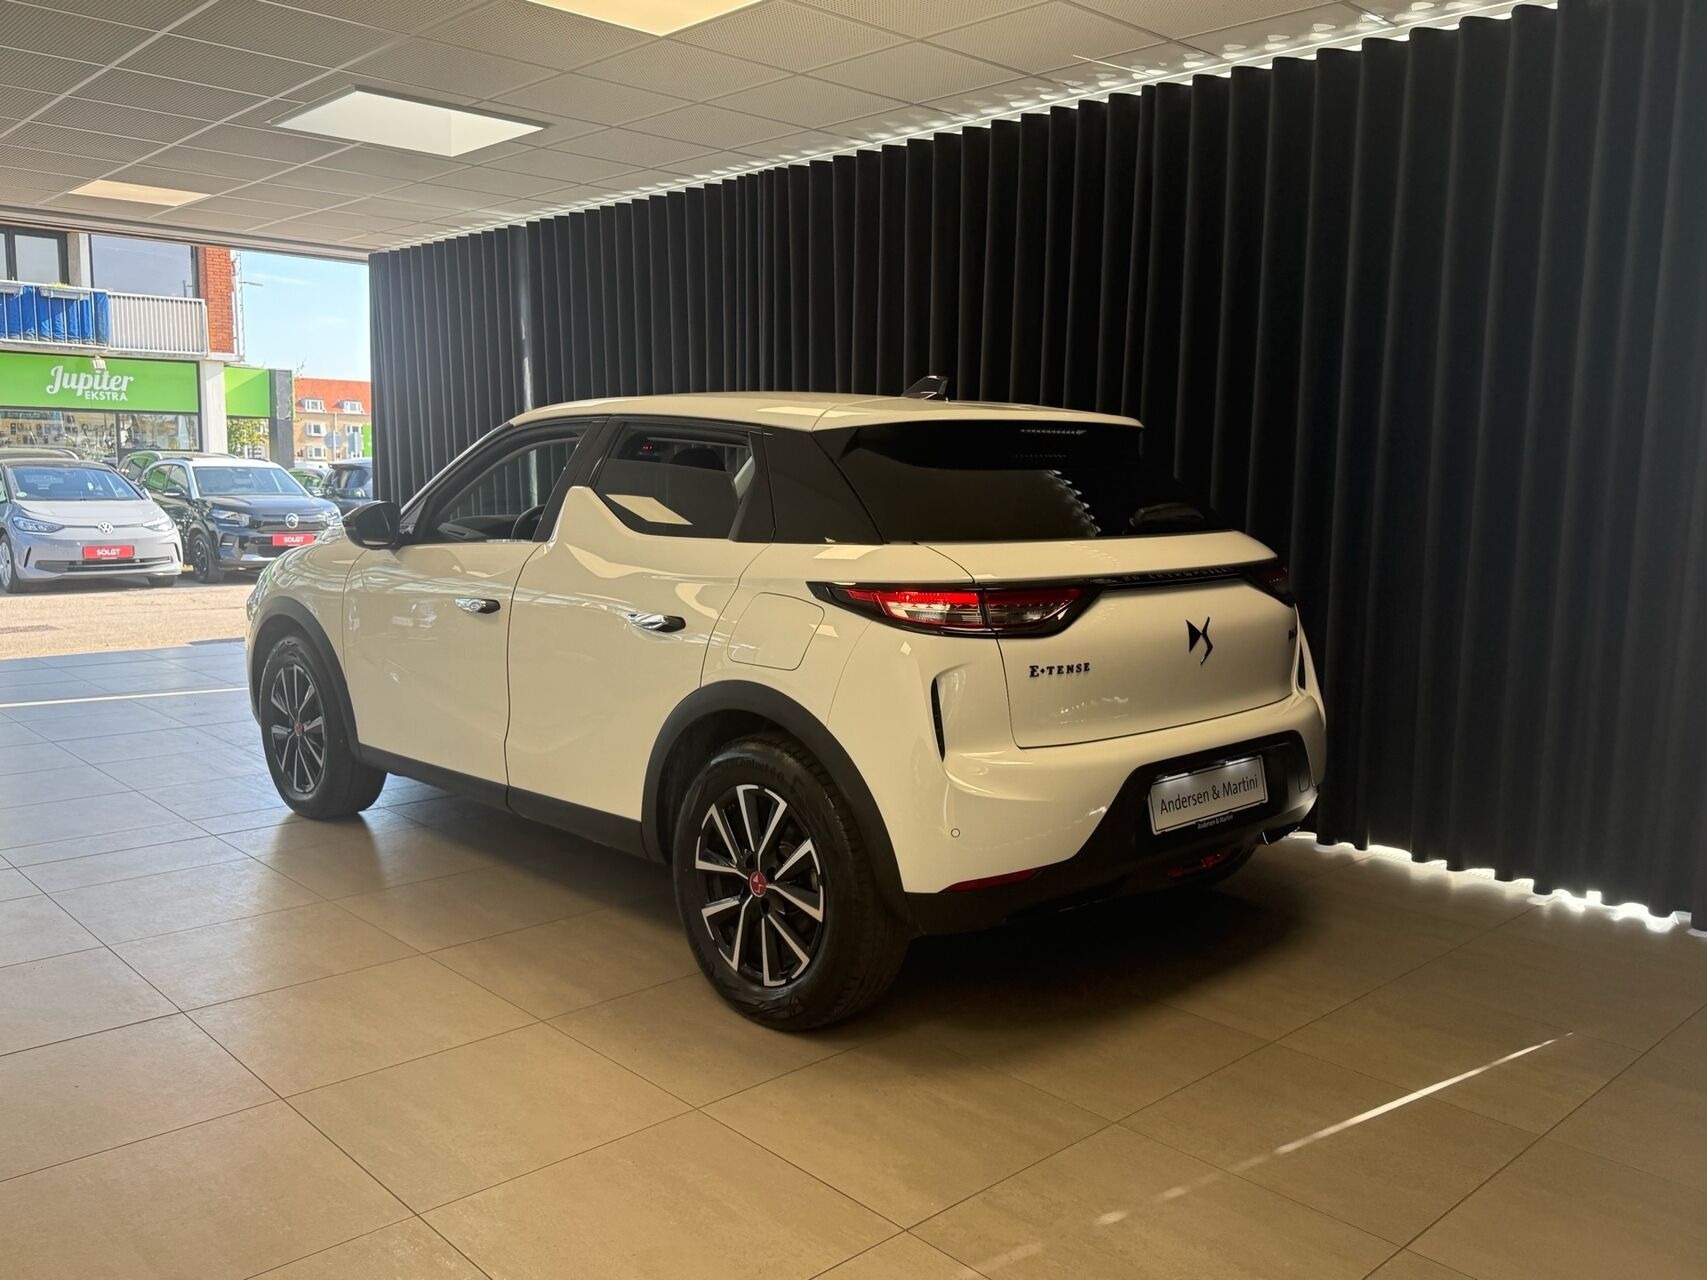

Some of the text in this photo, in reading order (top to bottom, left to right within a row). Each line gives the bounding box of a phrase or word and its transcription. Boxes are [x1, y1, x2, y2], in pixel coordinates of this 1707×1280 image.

[46, 365, 135, 396] Jupiter
[85, 391, 128, 401] EKSTRA
[96, 548, 121, 556] SOLGT
[1160, 774, 1258, 814] Andersen & Martini
